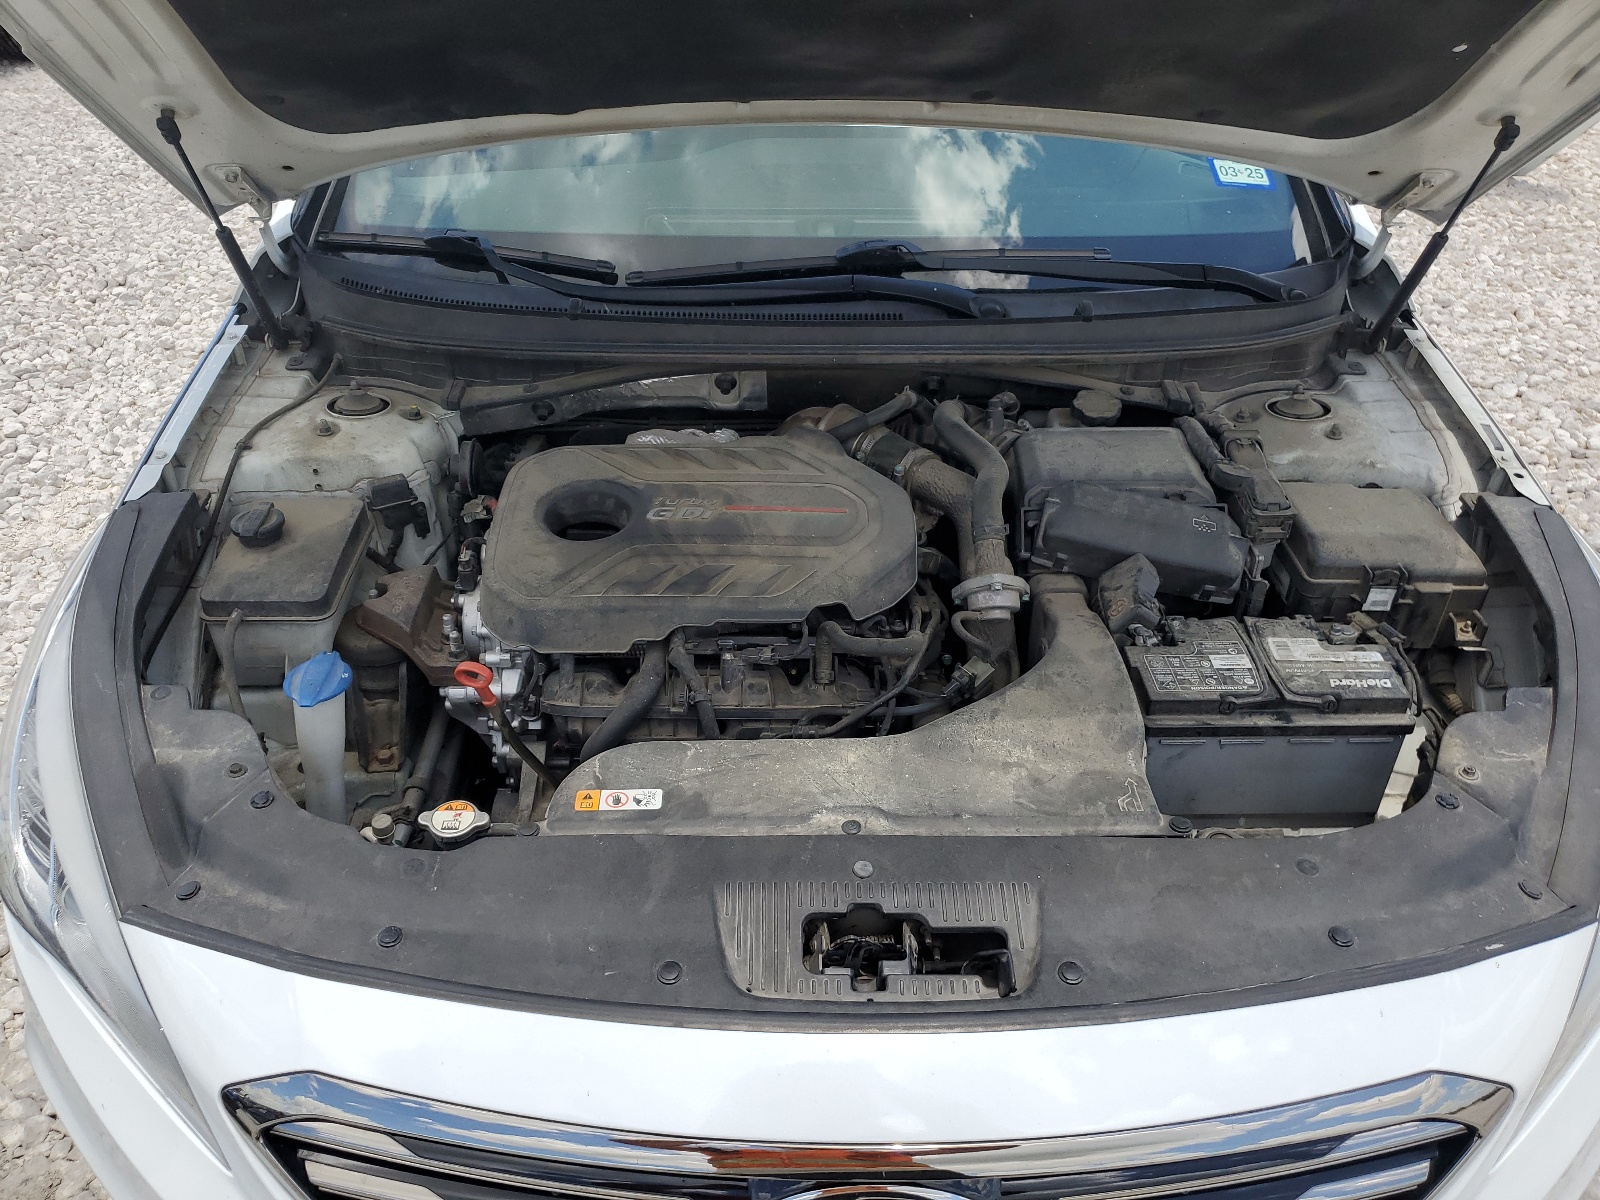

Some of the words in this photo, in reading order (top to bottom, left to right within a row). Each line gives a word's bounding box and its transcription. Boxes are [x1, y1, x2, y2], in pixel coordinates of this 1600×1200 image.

[1219, 165, 1238, 177] 03
[1245, 167, 1264, 179] 25
[653, 496, 718, 506] Turbo
[1329, 678, 1392, 688] DieHard
